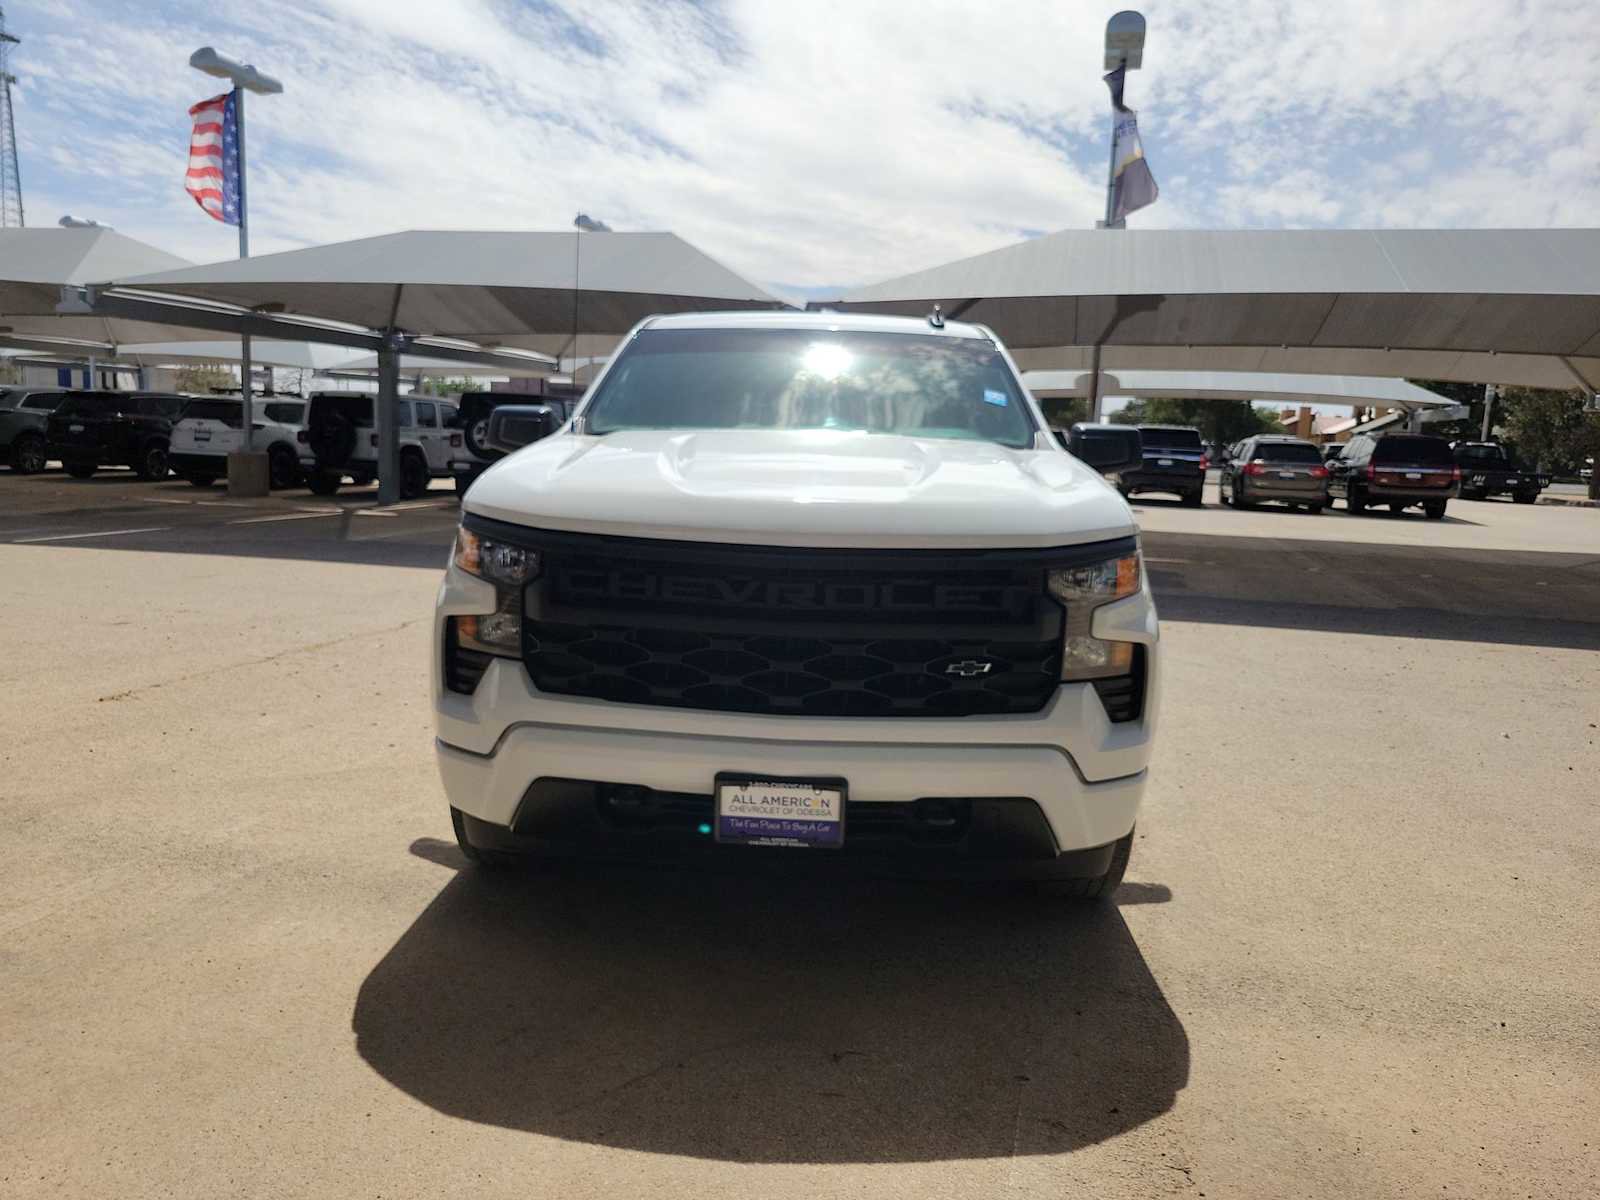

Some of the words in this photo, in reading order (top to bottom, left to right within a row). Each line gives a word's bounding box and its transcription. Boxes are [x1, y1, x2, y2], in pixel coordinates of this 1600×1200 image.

[562, 570, 1029, 612] CHEVROLET
[732, 794, 757, 805] ALL
[729, 804, 780, 815] CHEVROLET
[782, 805, 794, 815] OF
